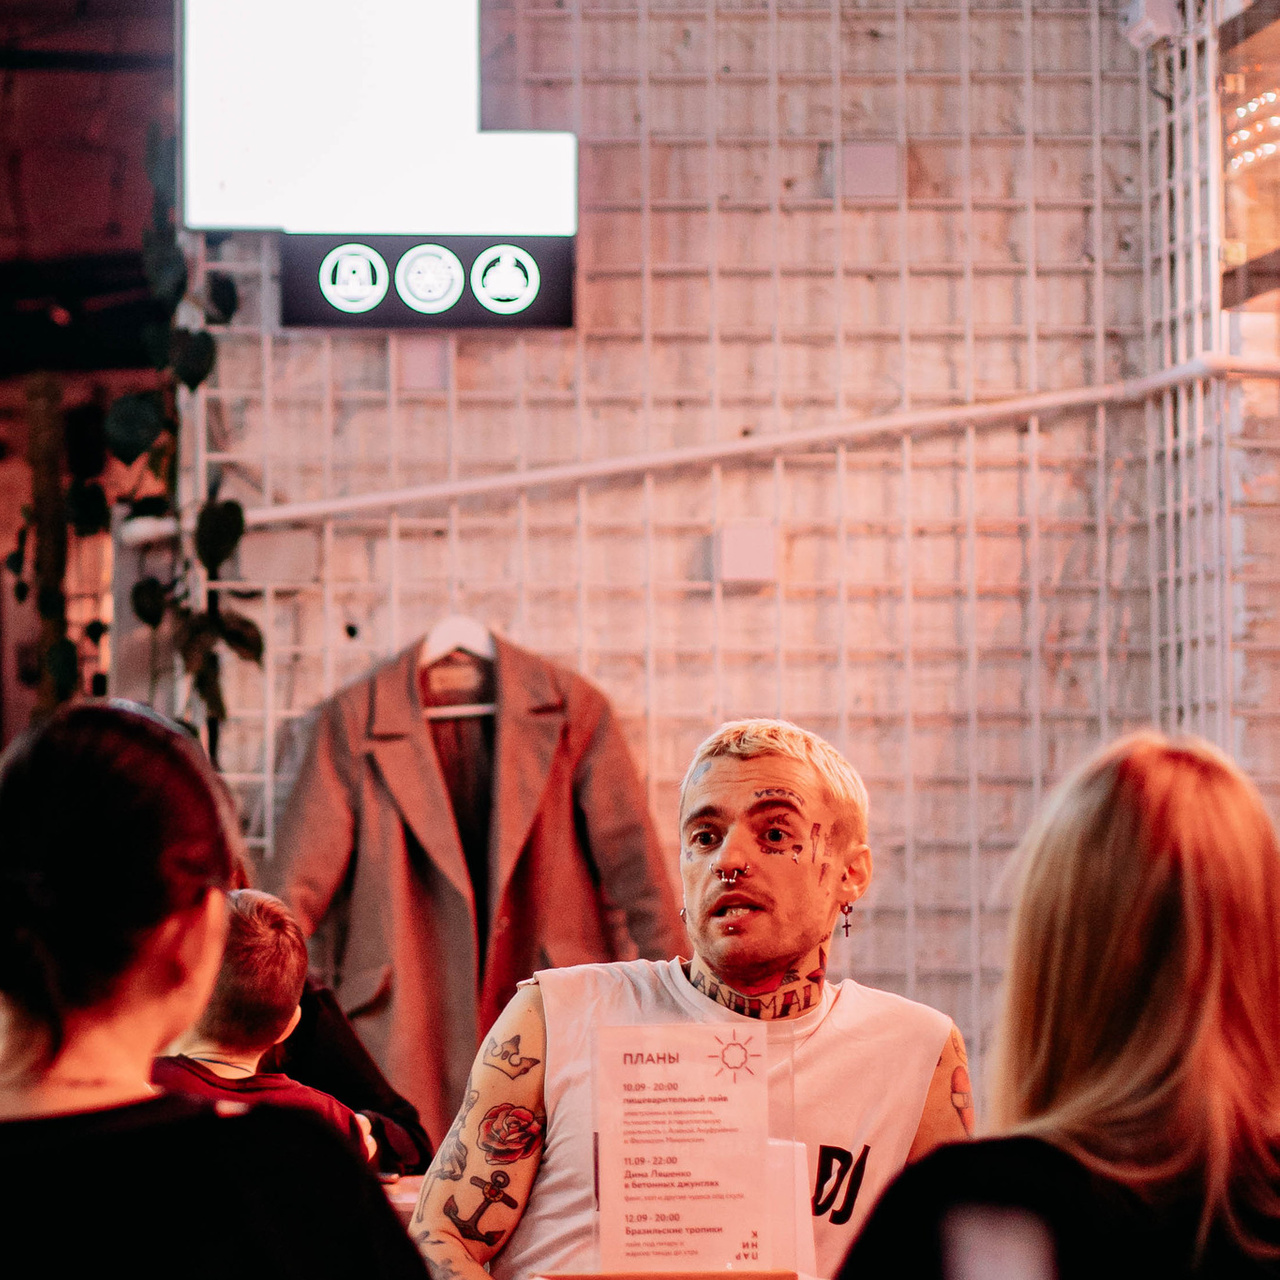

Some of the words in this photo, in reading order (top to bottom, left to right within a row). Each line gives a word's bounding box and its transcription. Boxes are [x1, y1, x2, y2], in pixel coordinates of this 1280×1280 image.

[623, 1052, 679, 1065] ПЛАНЫ
[623, 1083, 646, 1091] 10.09
[653, 1082, 678, 1091] 20:00
[624, 1157, 645, 1166] 11.09
[652, 1156, 678, 1165] 22:00
[625, 1214, 648, 1223] 12.09
[655, 1213, 680, 1222] 20:00
[625, 1226, 682, 1236] Бразильские
[685, 1226, 723, 1235] тропики
